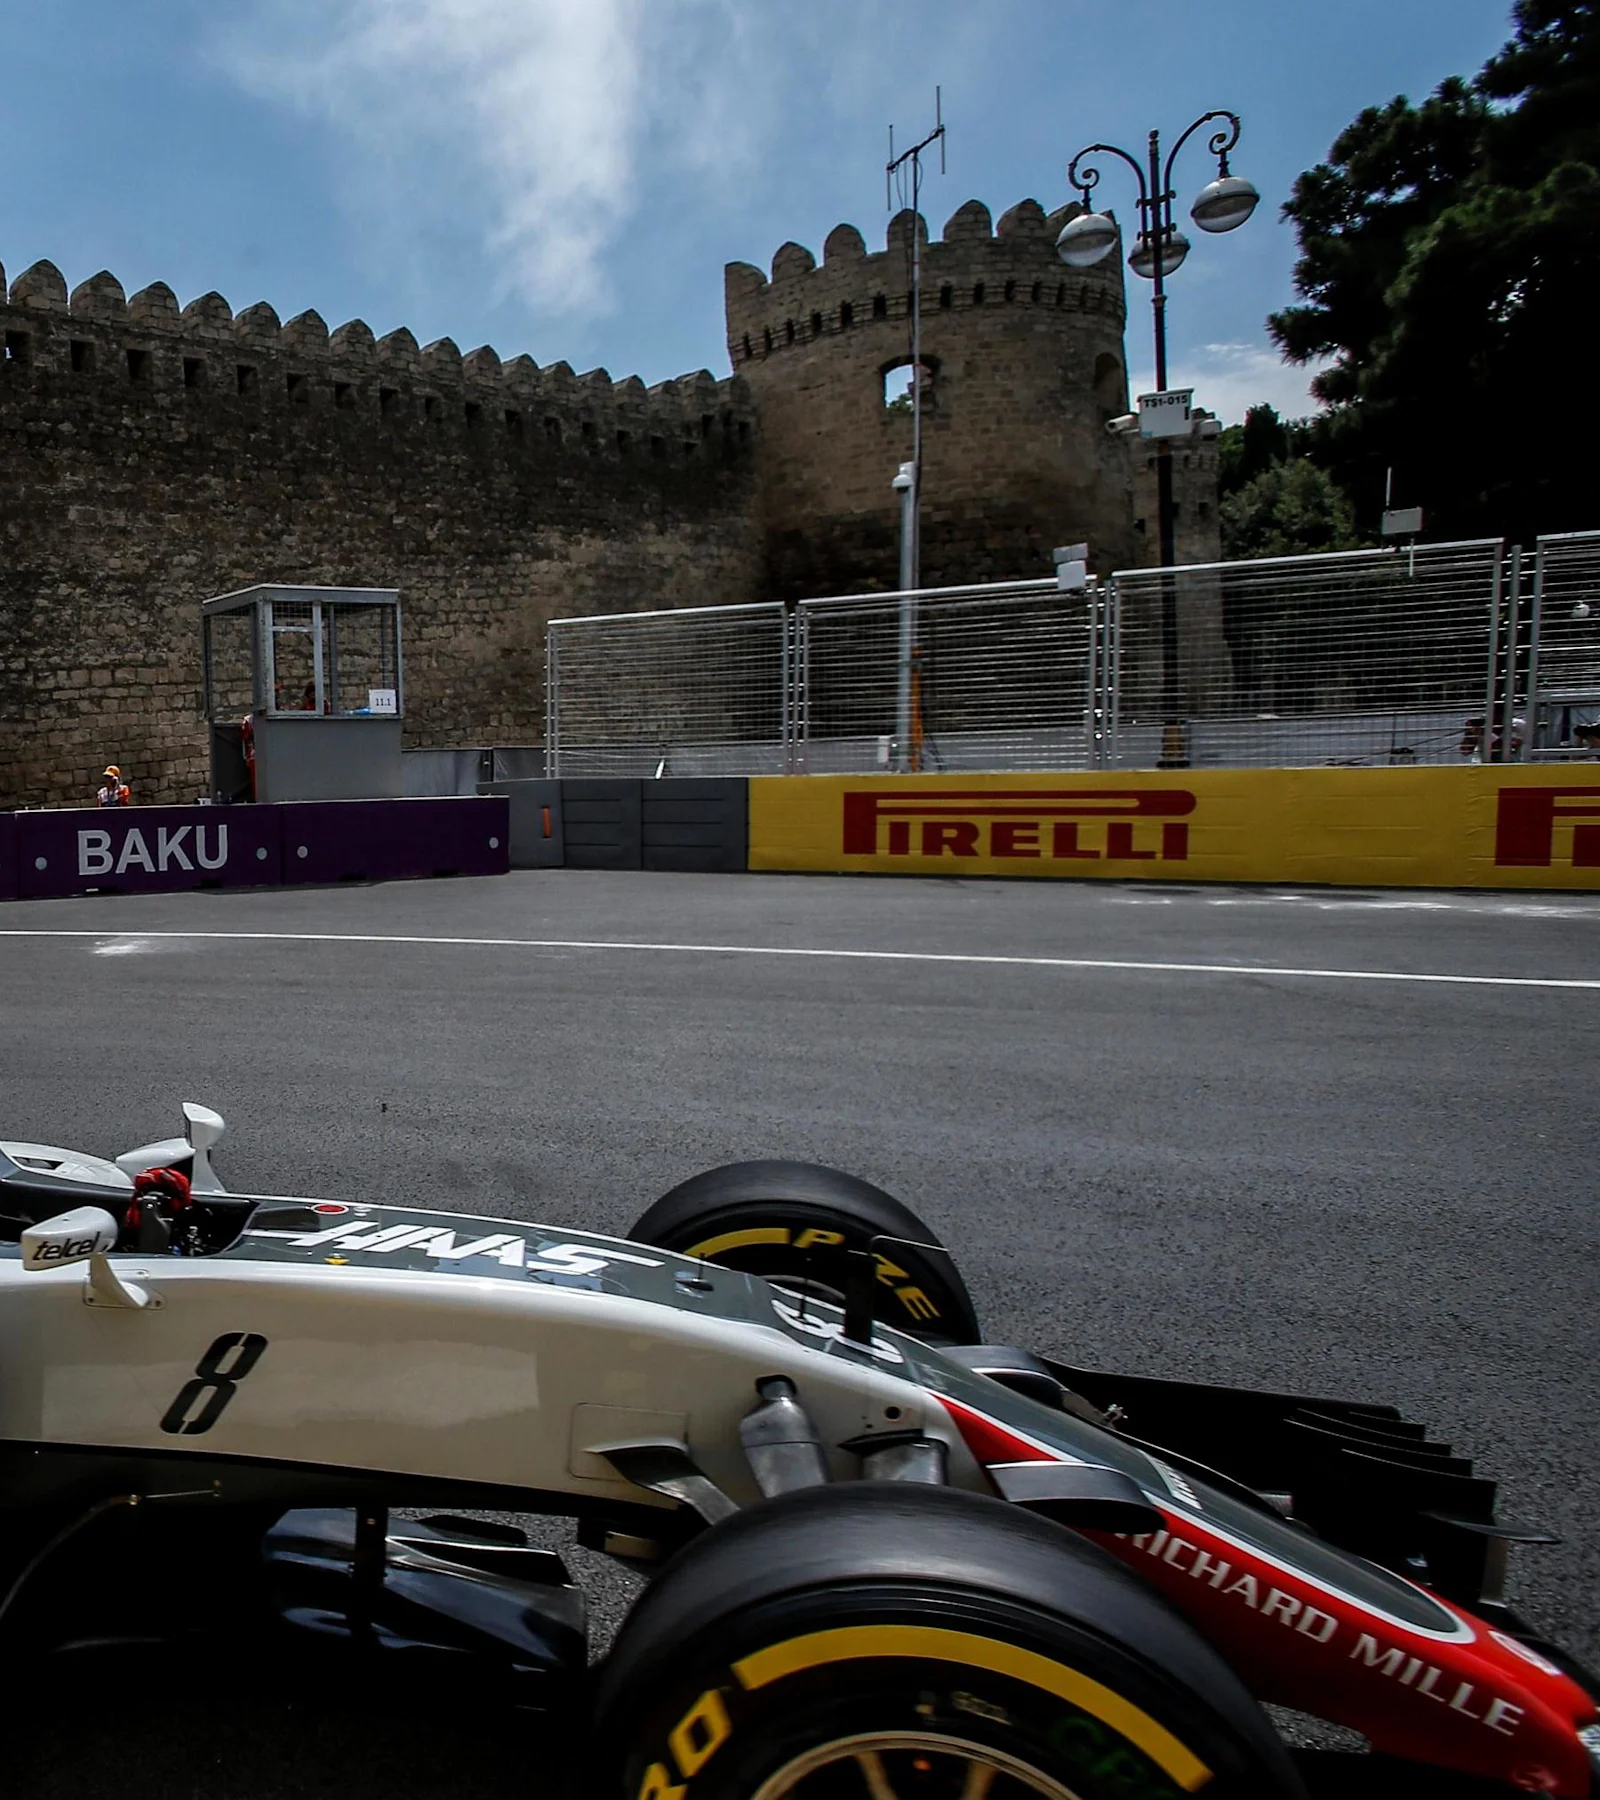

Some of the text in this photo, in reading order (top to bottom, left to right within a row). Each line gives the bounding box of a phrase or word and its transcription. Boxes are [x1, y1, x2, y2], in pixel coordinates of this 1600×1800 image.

[1144, 395, 1188, 408] TS1-015
[77, 823, 229, 877] BAKU
[843, 789, 1197, 861] PIRELLI
[32, 1231, 101, 1260] telcel
[288, 1221, 665, 1276] HAAS
[160, 1331, 268, 1435] 8
[1348, 1633, 1526, 1737] MILLE
